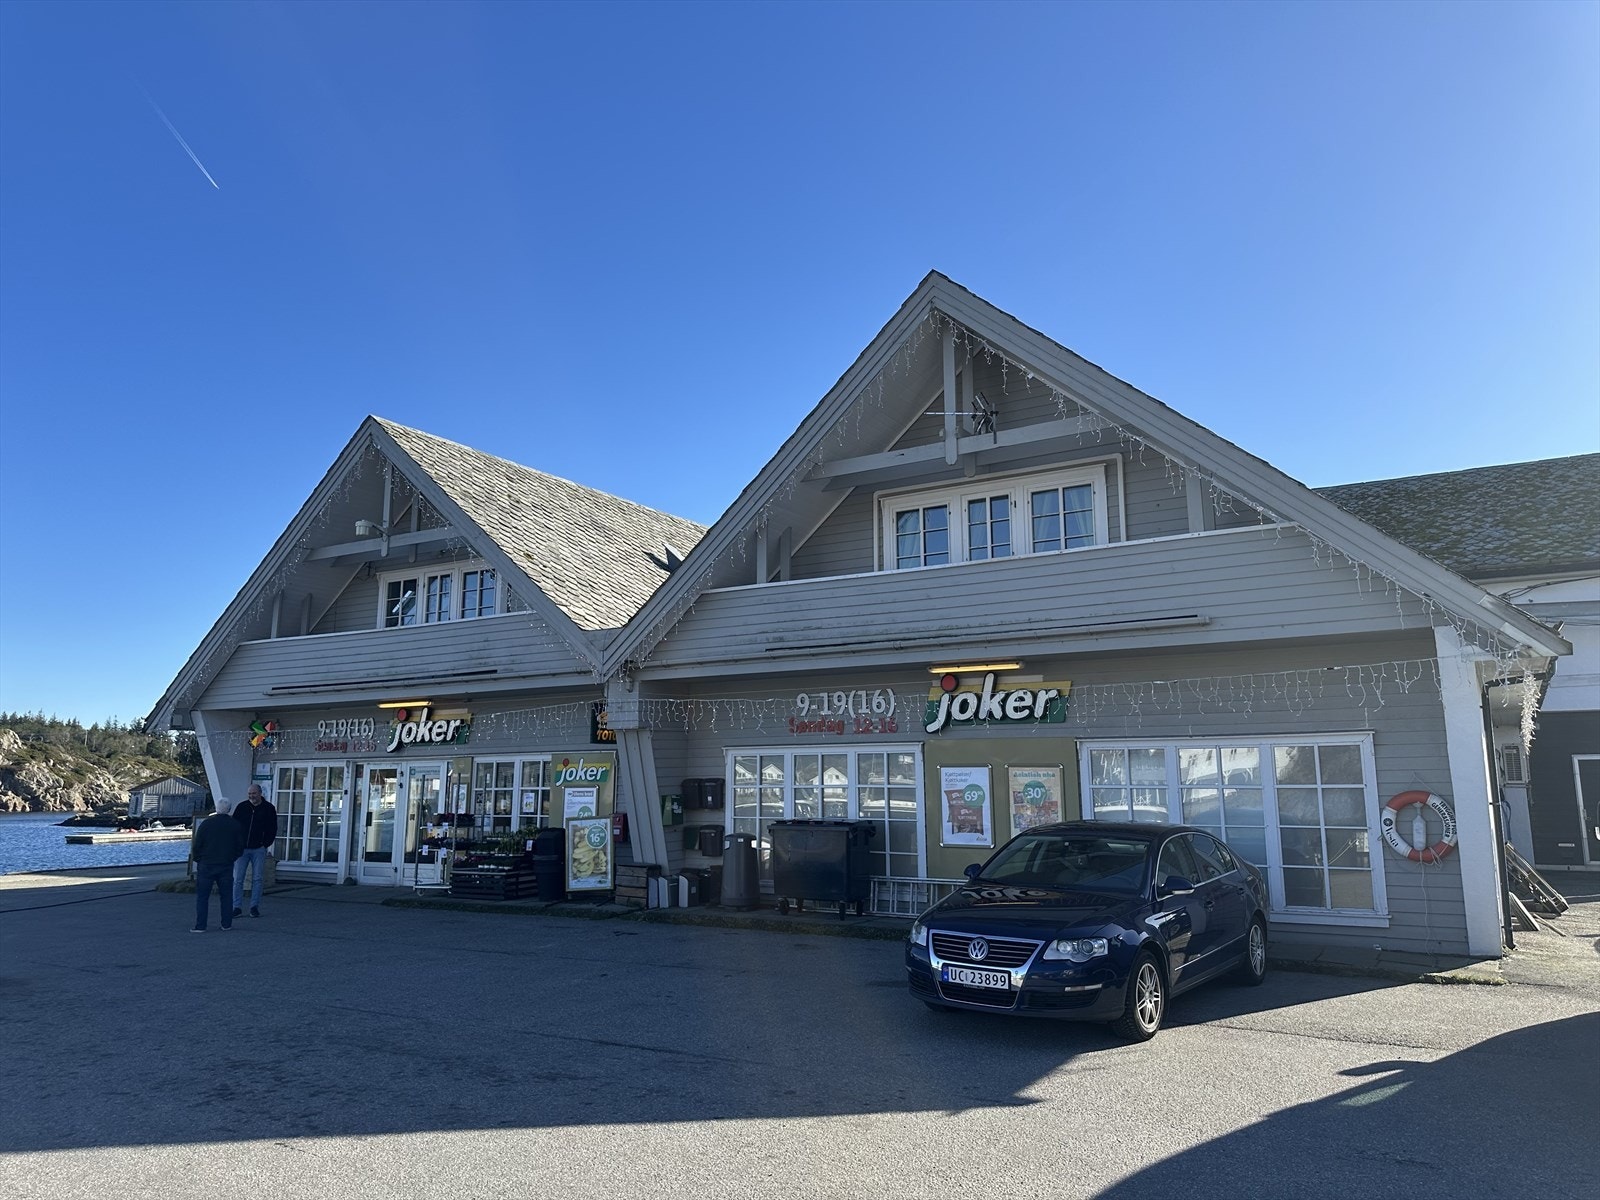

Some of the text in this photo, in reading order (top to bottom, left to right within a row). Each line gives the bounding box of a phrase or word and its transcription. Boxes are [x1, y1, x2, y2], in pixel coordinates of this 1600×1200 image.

[796, 688, 896, 717] 9-19(16)
[925, 672, 1059, 734] joker
[318, 717, 375, 740] 9-19(16)
[387, 707, 461, 753] joker
[555, 757, 607, 787] joker
[950, 968, 1007, 987] UC 23899
